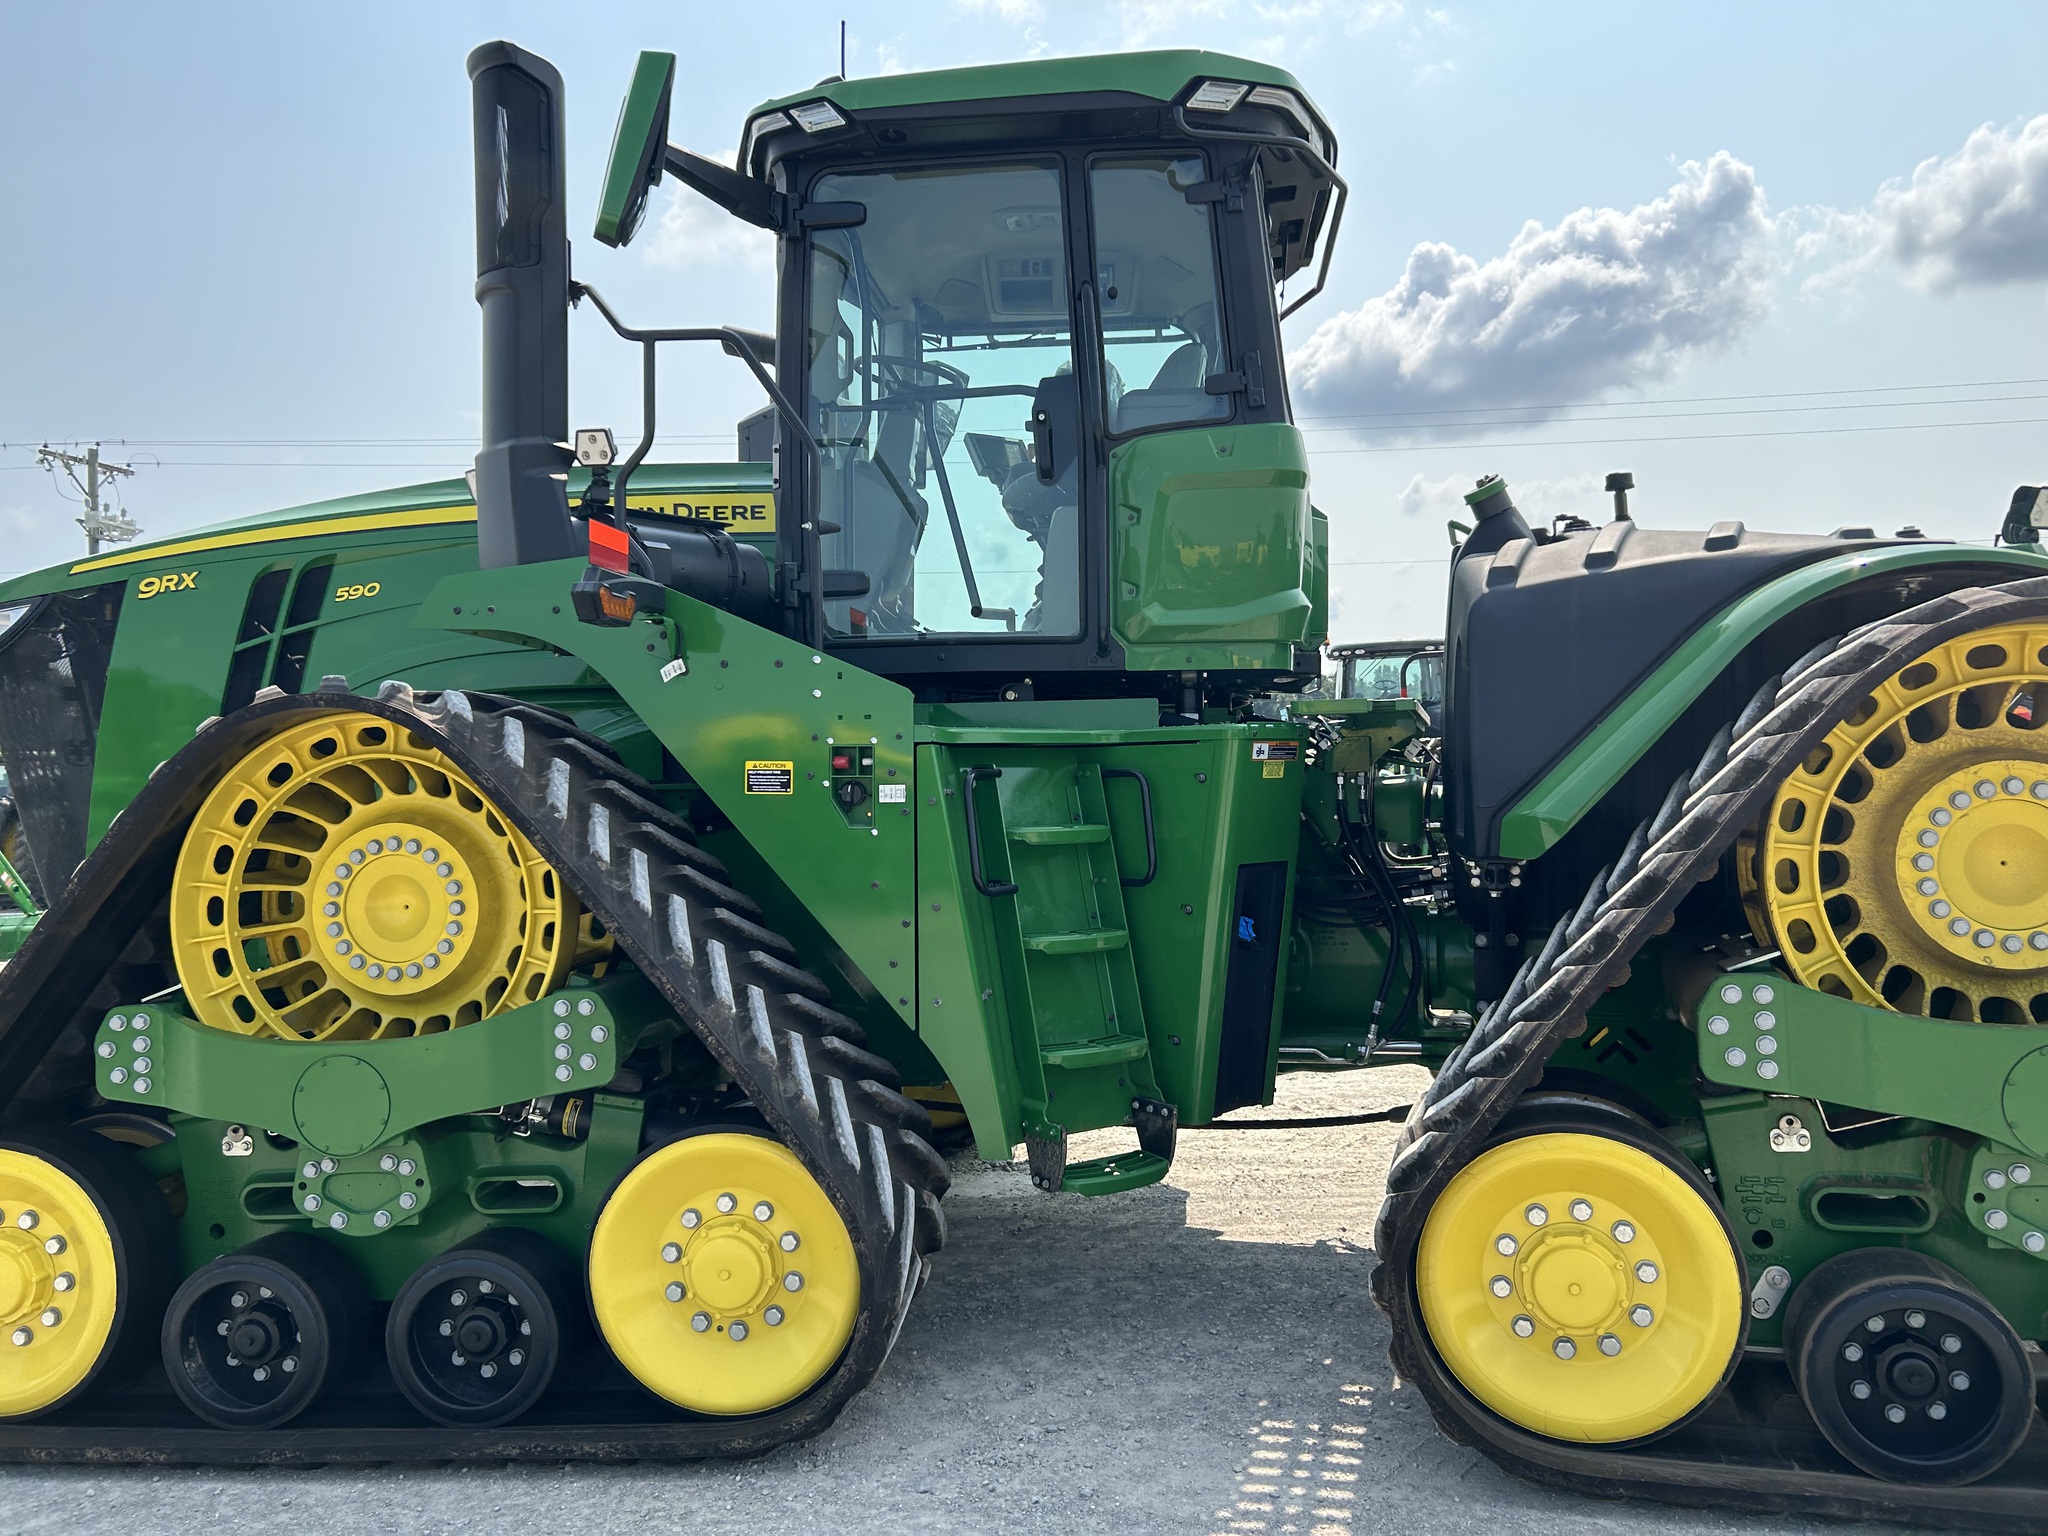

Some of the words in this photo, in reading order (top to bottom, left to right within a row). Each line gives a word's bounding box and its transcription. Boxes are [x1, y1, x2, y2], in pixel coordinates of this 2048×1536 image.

[673, 503, 766, 520] DEERE
[137, 571, 199, 600] 9RX
[335, 581, 381, 602] 590
